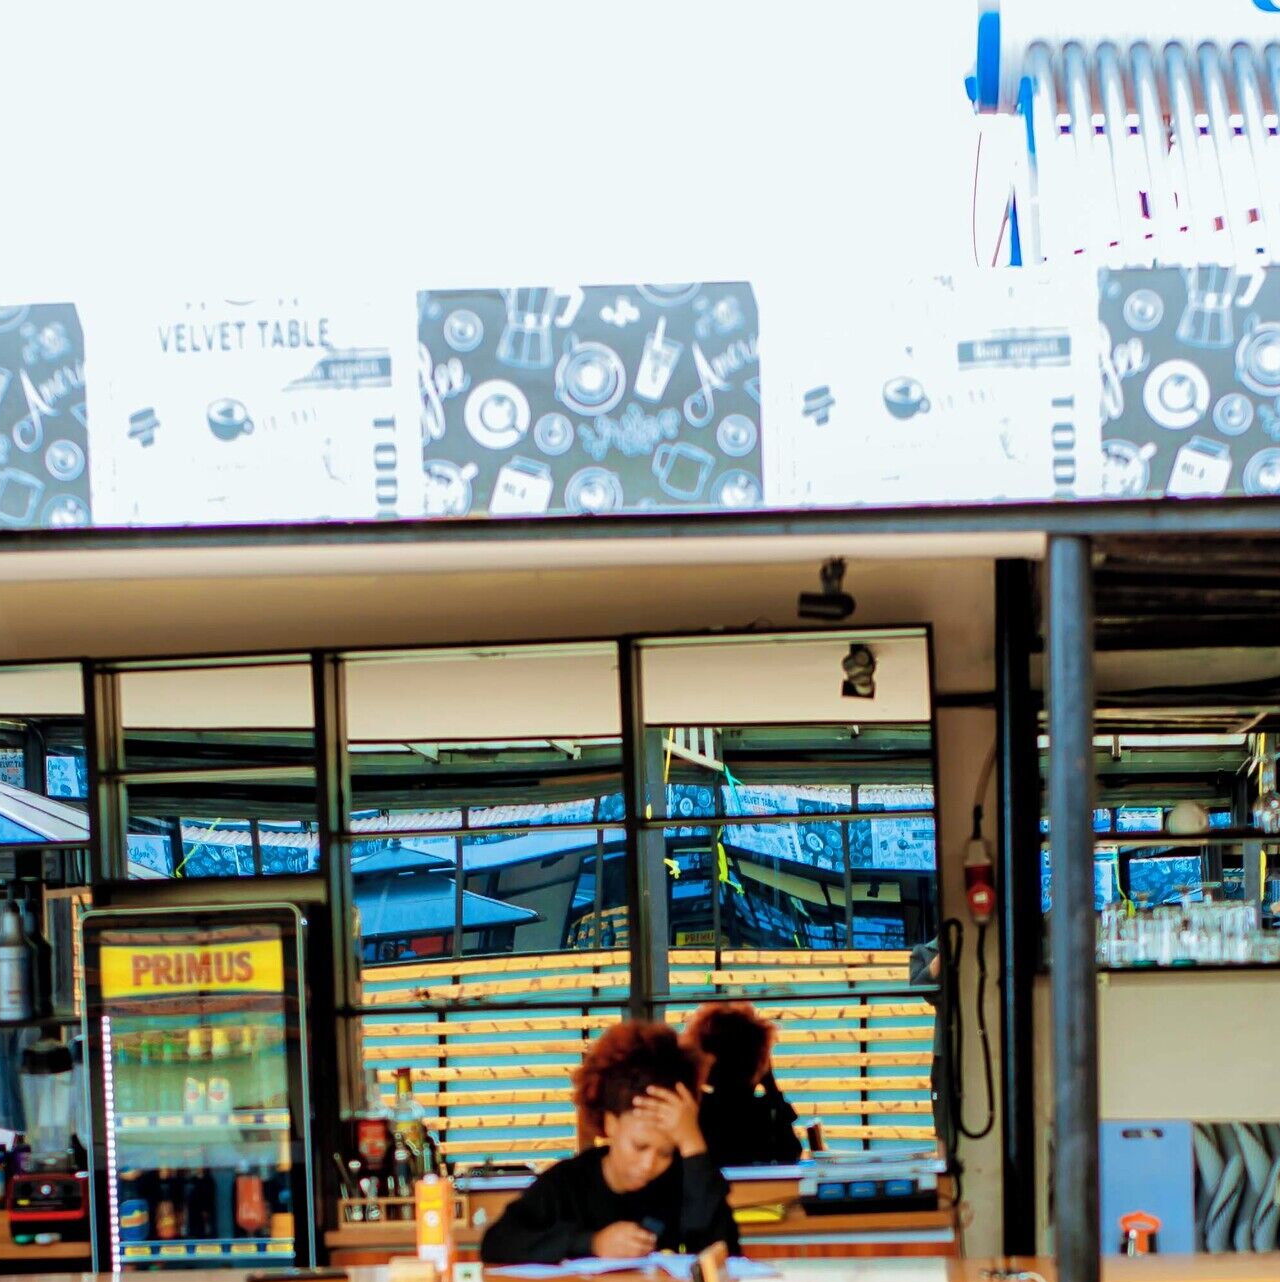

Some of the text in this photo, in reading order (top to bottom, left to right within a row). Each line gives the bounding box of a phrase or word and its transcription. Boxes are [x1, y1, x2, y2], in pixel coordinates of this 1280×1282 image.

[157, 317, 331, 354] VELVET TABLE
[131, 950, 256, 987] PRIMUS
